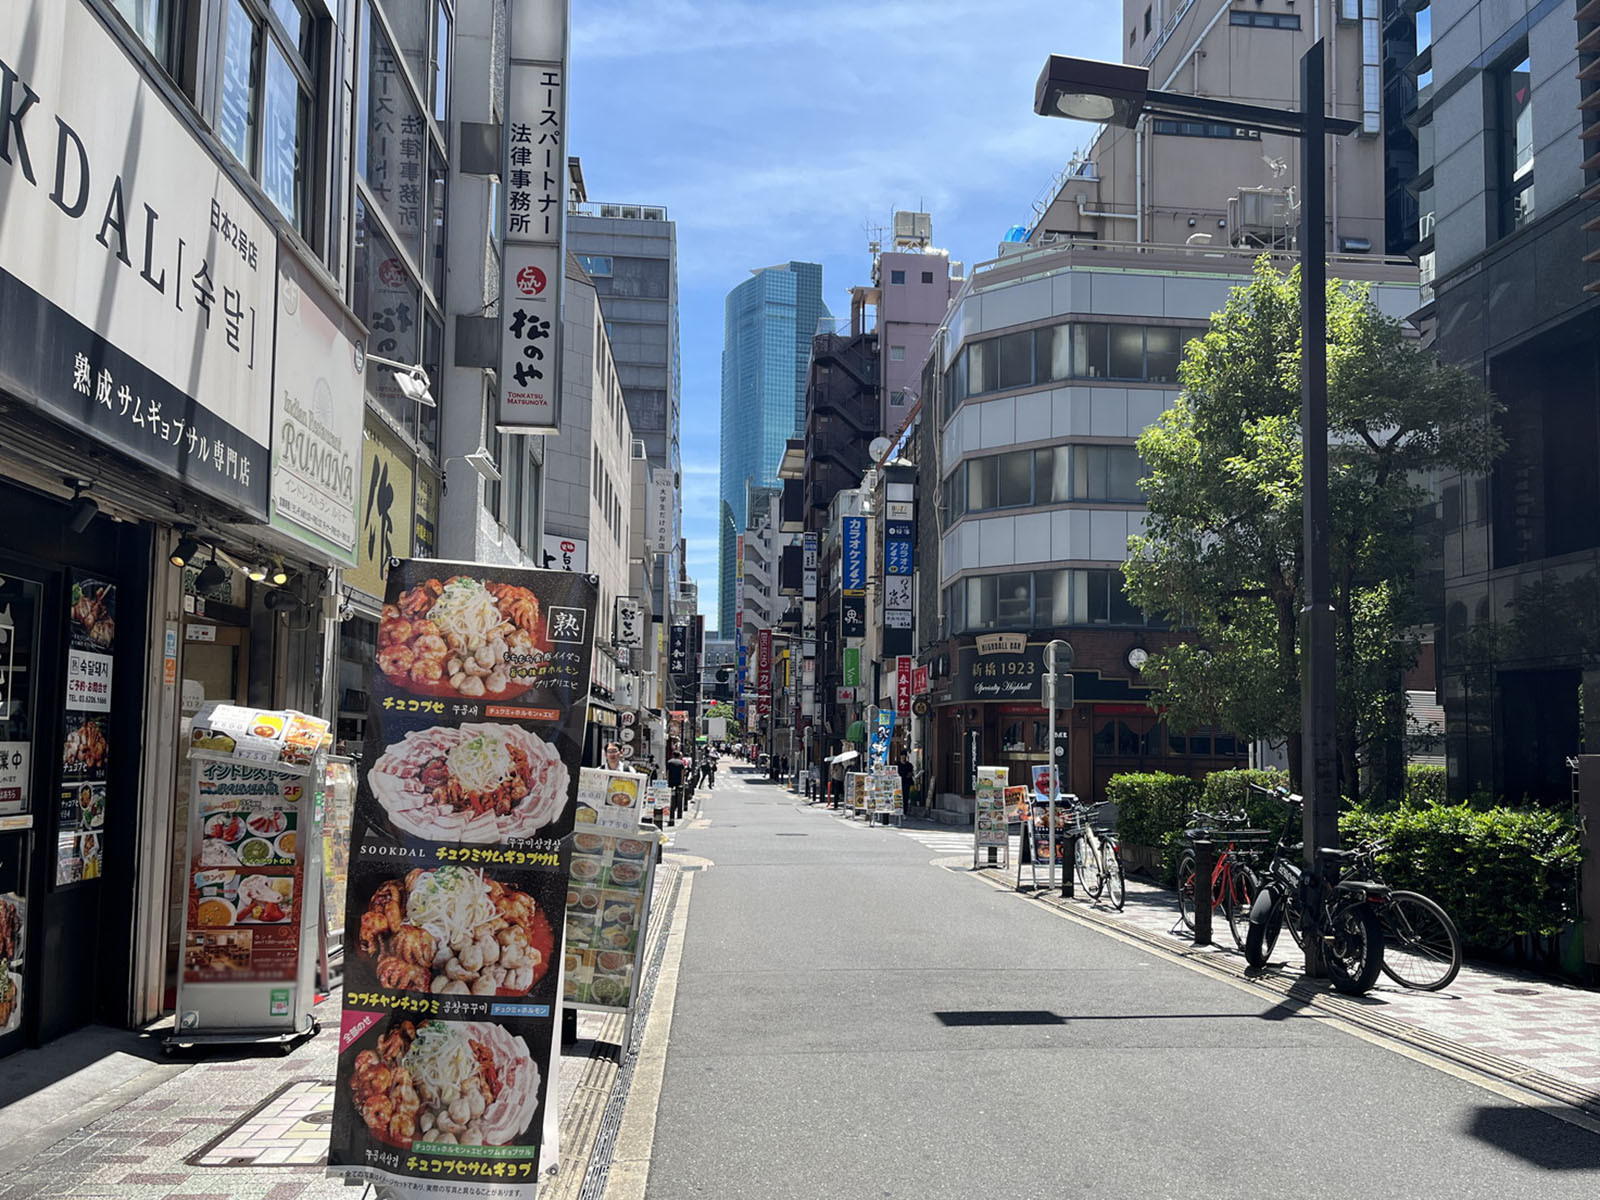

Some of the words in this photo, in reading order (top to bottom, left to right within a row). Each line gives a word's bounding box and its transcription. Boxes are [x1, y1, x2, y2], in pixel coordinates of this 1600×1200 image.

[538, 72, 561, 234] エースパートナー
[509, 123, 532, 234] 法律事務所
[210, 198, 258, 272] 日本2号店
[509, 308, 550, 388] 松のや
[899, 542, 909, 574] カラオケ
[553, 612, 579, 637] 熟
[80, 659, 108, 677] 숙달돼지
[1001, 662, 1035, 675] 1923
[284, 786, 300, 795] 2F
[360, 846, 426, 857] SOOKDAL
